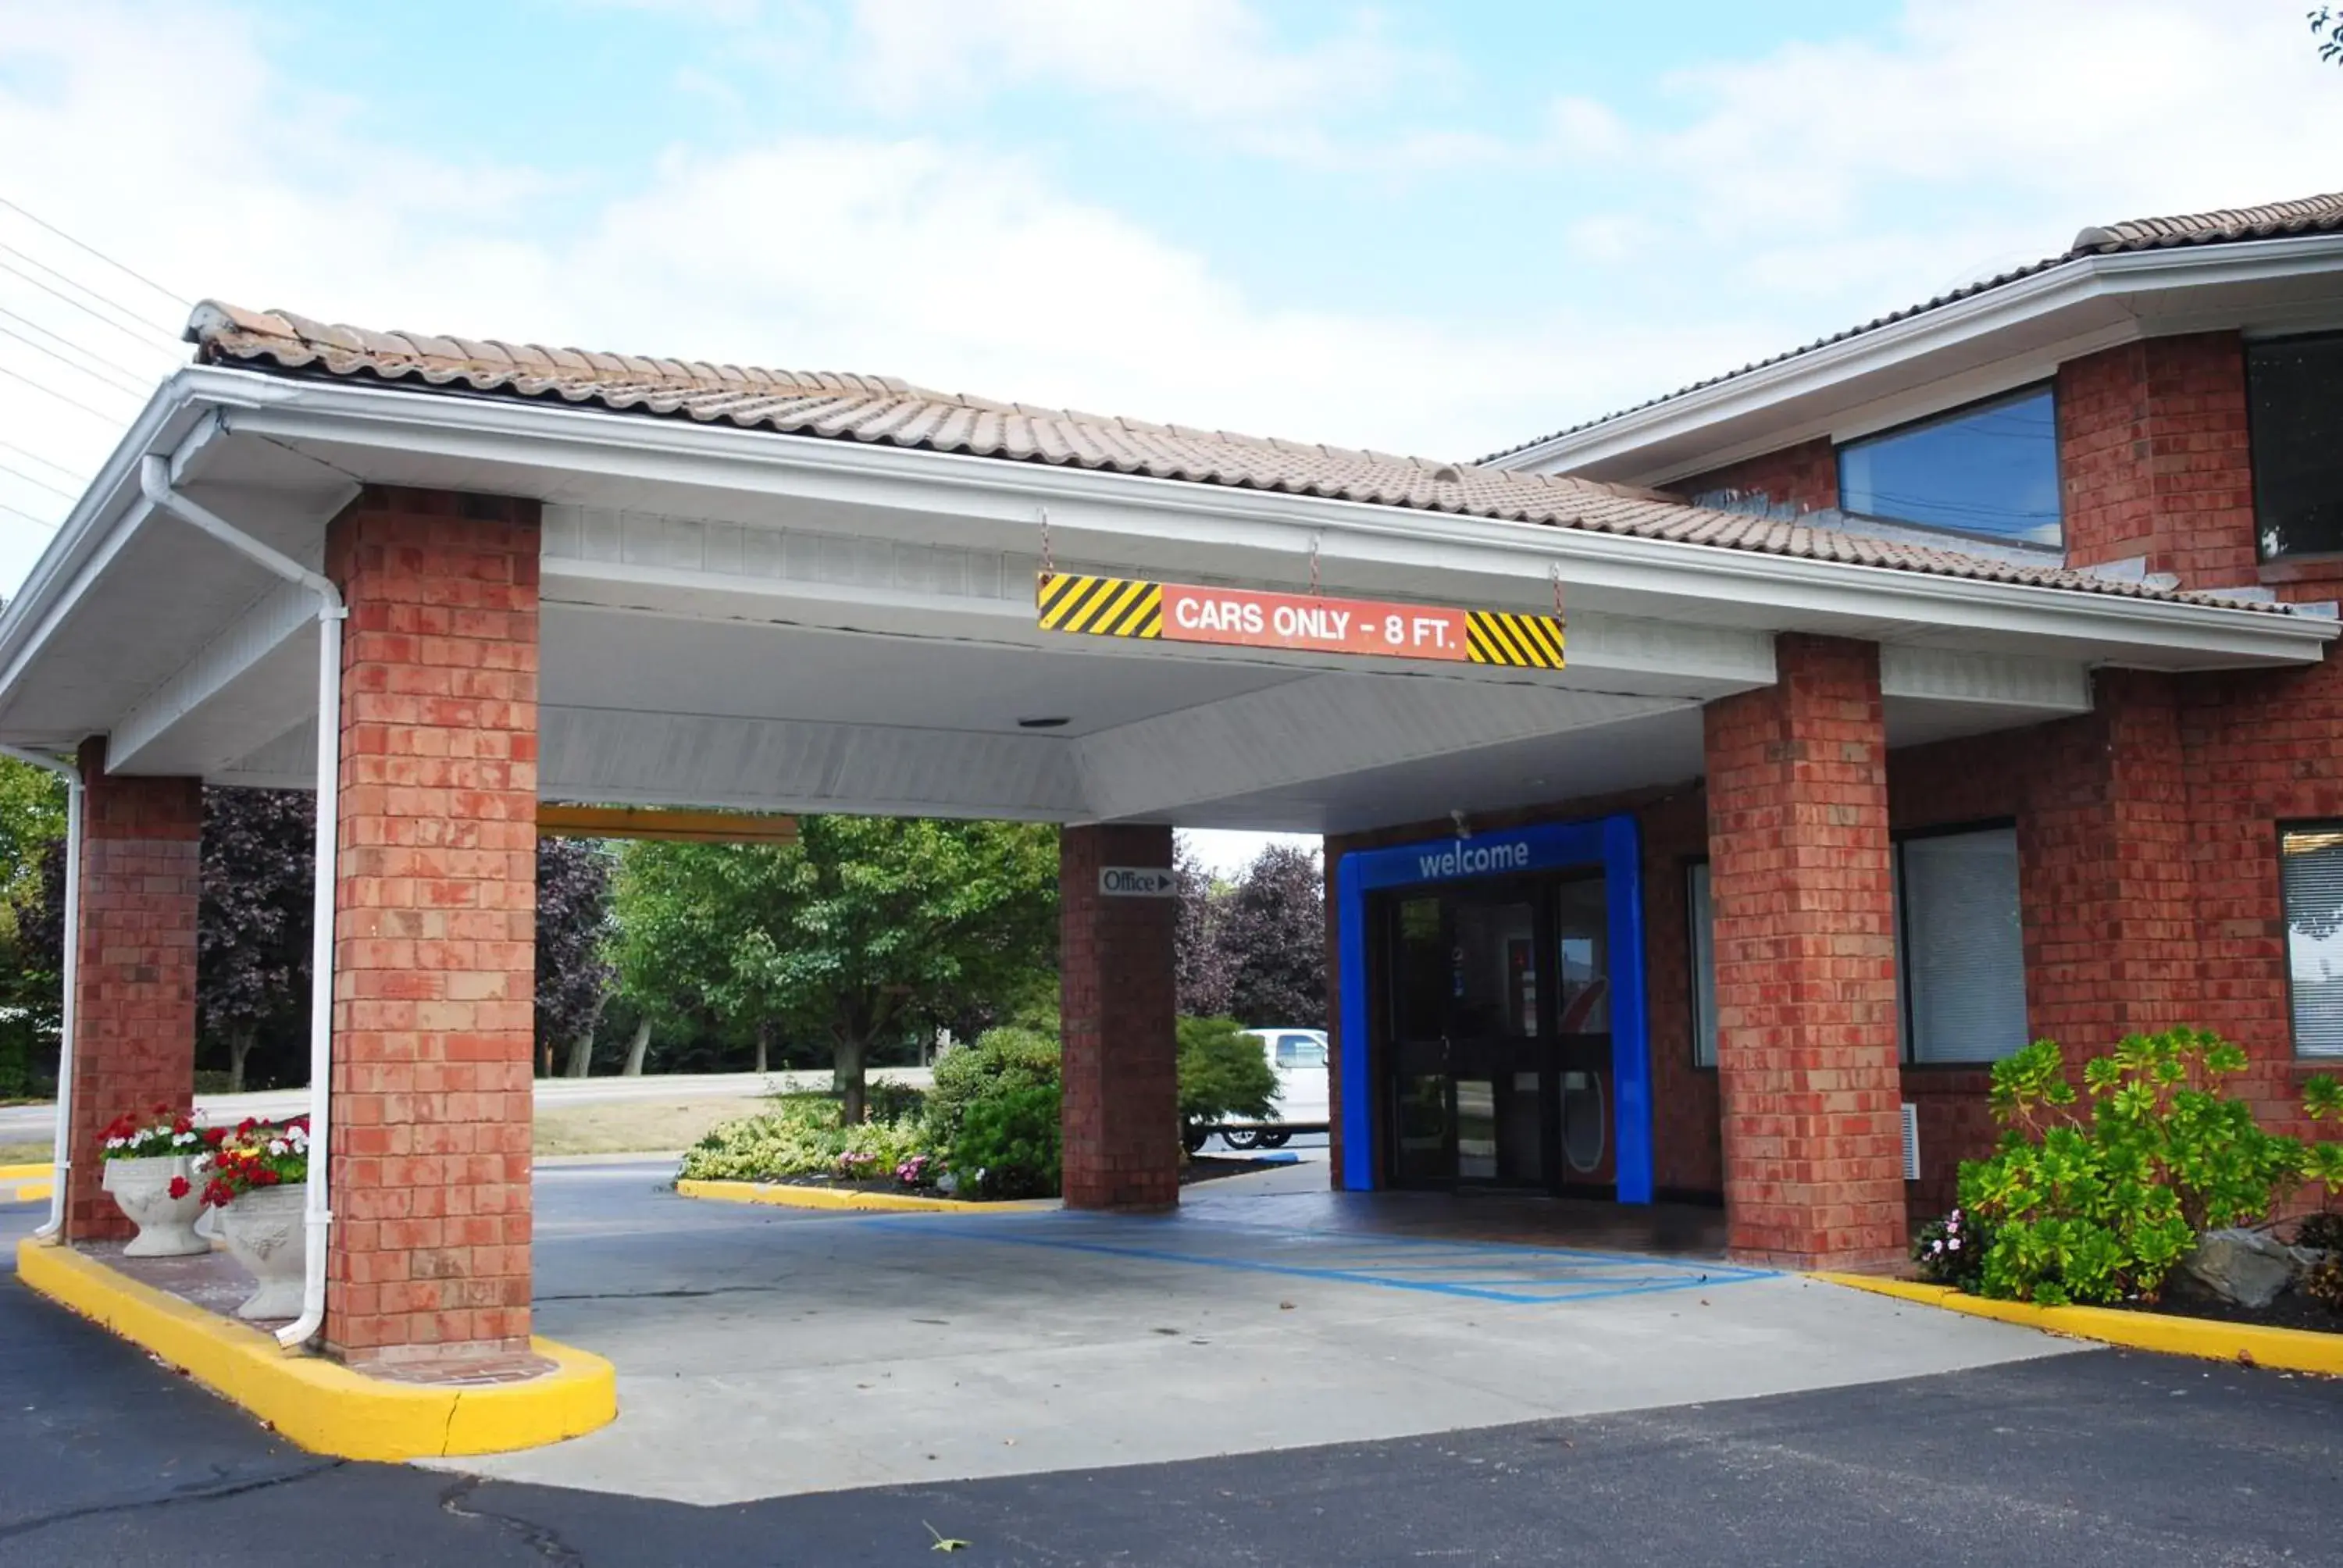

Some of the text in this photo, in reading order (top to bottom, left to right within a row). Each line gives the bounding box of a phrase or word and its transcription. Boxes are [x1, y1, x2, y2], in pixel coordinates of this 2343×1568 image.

[1175, 597, 1264, 633] CARS
[1274, 606, 1350, 640] ONLY
[1385, 616, 1405, 645] 8
[1414, 619, 1456, 649] FT.
[1420, 840, 1528, 878] welcome
[1104, 870, 1154, 891] Office
